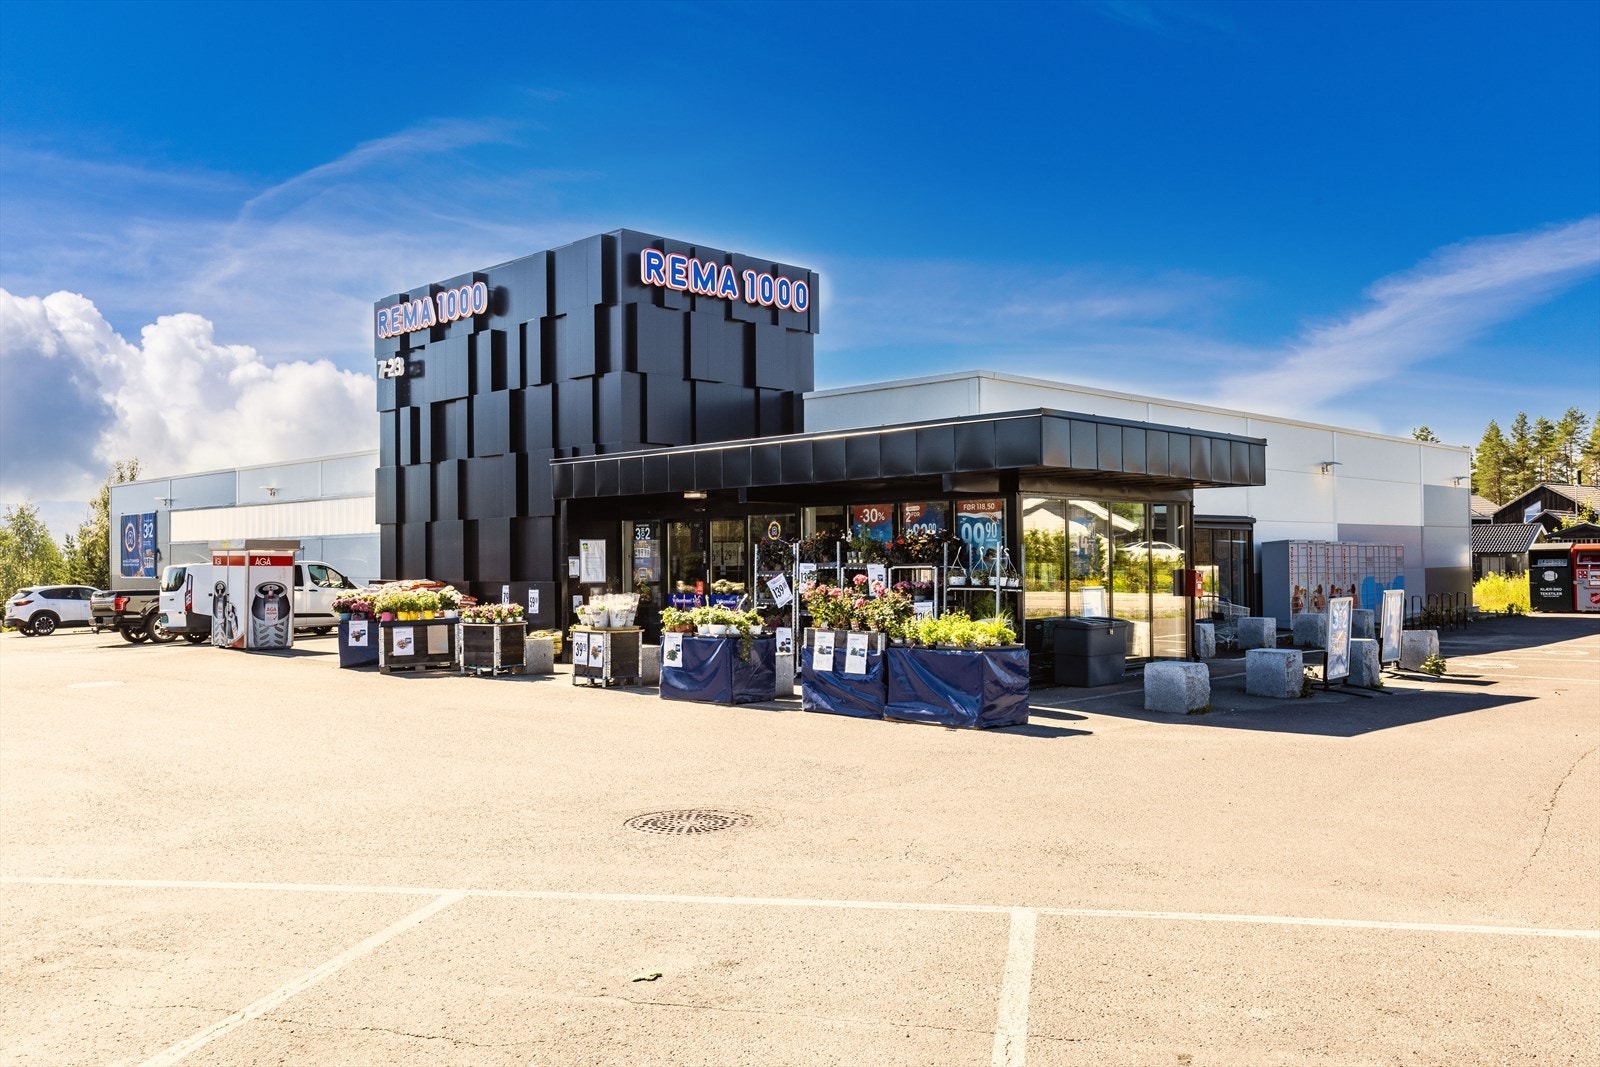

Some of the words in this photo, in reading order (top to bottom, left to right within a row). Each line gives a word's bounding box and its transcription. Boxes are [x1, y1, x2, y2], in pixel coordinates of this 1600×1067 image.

[641, 248, 739, 300] REMA
[742, 269, 809, 313] 1000
[377, 296, 436, 338] REMA
[436, 281, 488, 323] 1000
[377, 356, 405, 379] 7-23
[963, 503, 976, 511] FØR
[976, 502, 995, 511] 118,50
[859, 508, 885, 523] -30%
[905, 512, 912, 523] 2
[635, 527, 641, 540] 3
[645, 527, 651, 540] 2
[985, 522, 998, 539] 90
[254, 557, 272, 566] AGA
[772, 584, 785, 599] 139
[575, 642, 583, 657] 39
